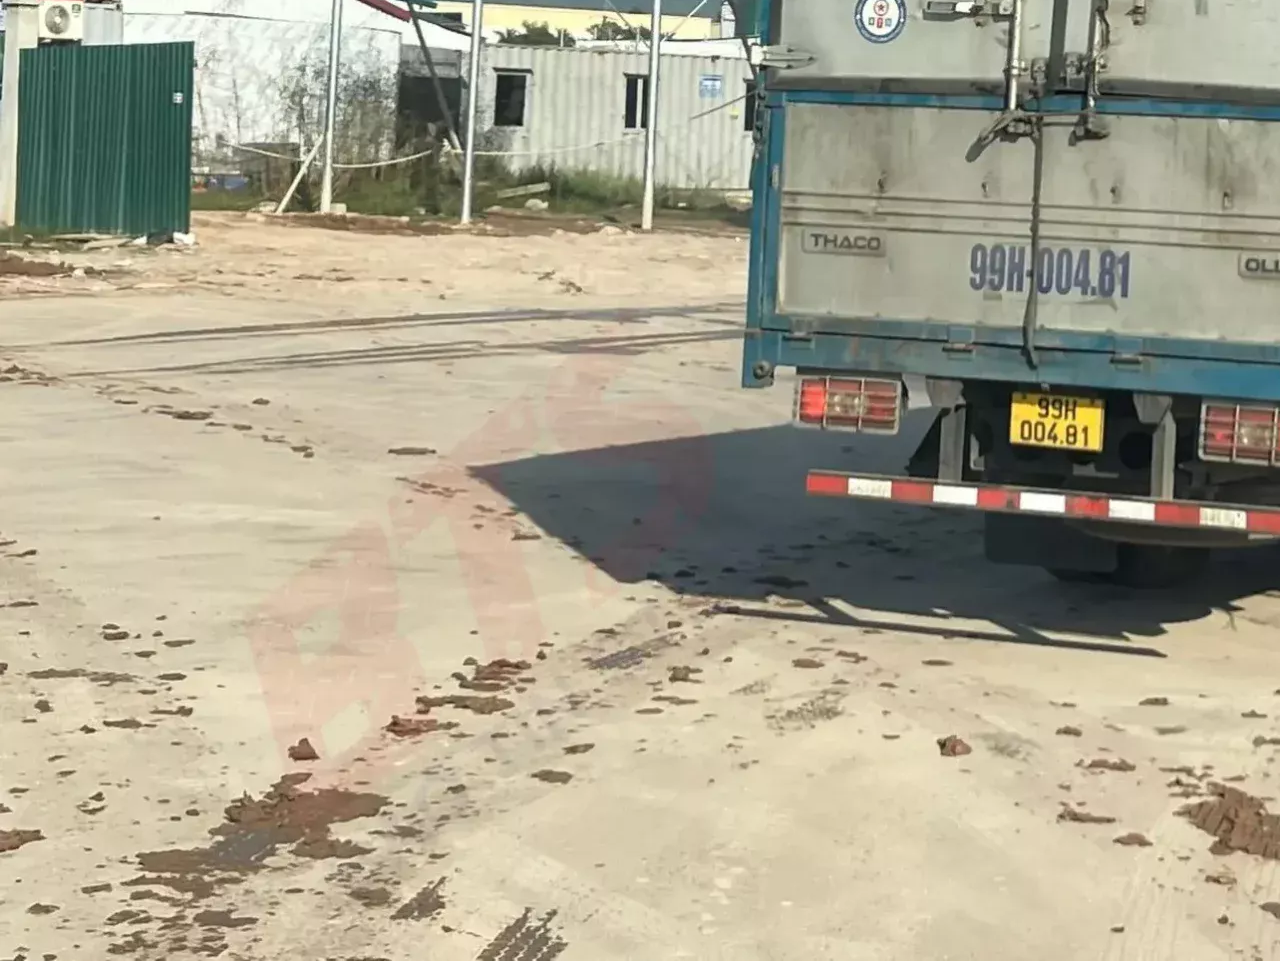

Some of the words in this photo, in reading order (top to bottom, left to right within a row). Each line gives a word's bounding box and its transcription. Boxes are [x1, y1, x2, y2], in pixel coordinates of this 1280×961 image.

[809, 232, 882, 251] THACO
[969, 243, 1132, 299] 99H-004.81
[1036, 397, 1078, 422] 99H
[1018, 419, 1090, 448] 004.81
